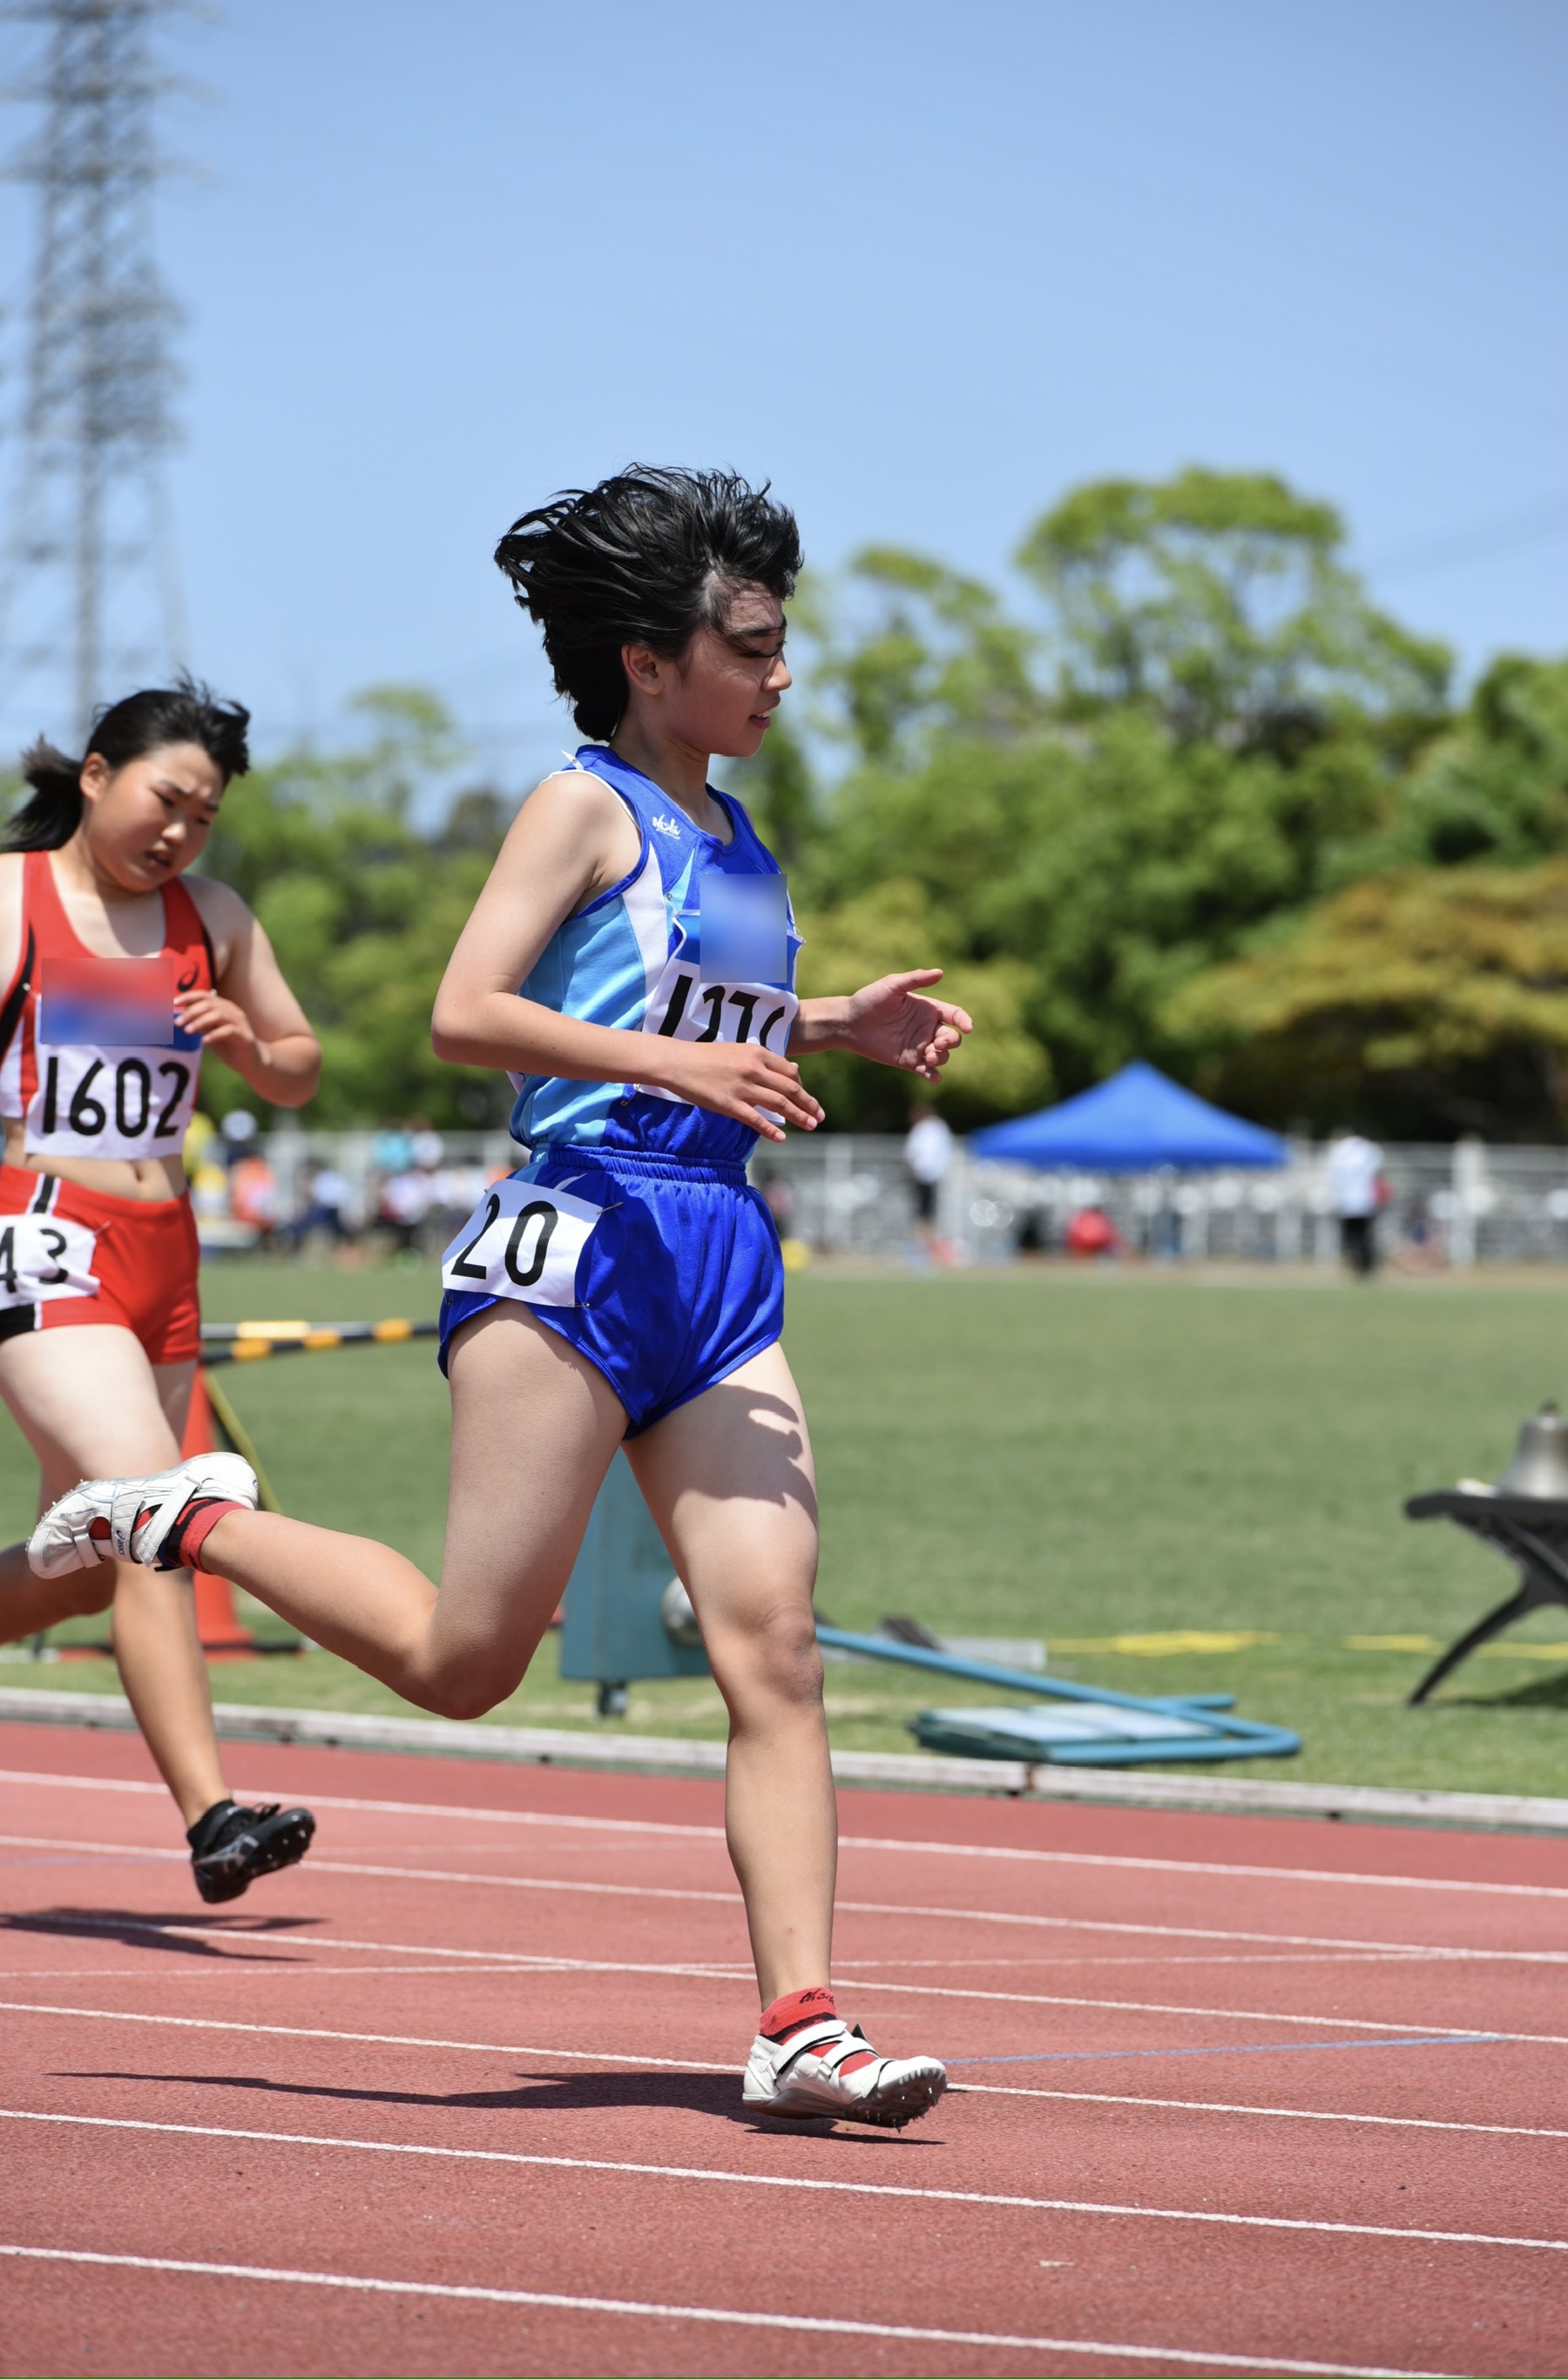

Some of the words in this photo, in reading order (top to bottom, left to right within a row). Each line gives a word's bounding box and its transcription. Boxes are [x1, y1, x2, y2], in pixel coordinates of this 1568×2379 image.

[42, 1057, 190, 1139] 1602
[0, 1227, 68, 1294] 43
[450, 1193, 558, 1287] 20
